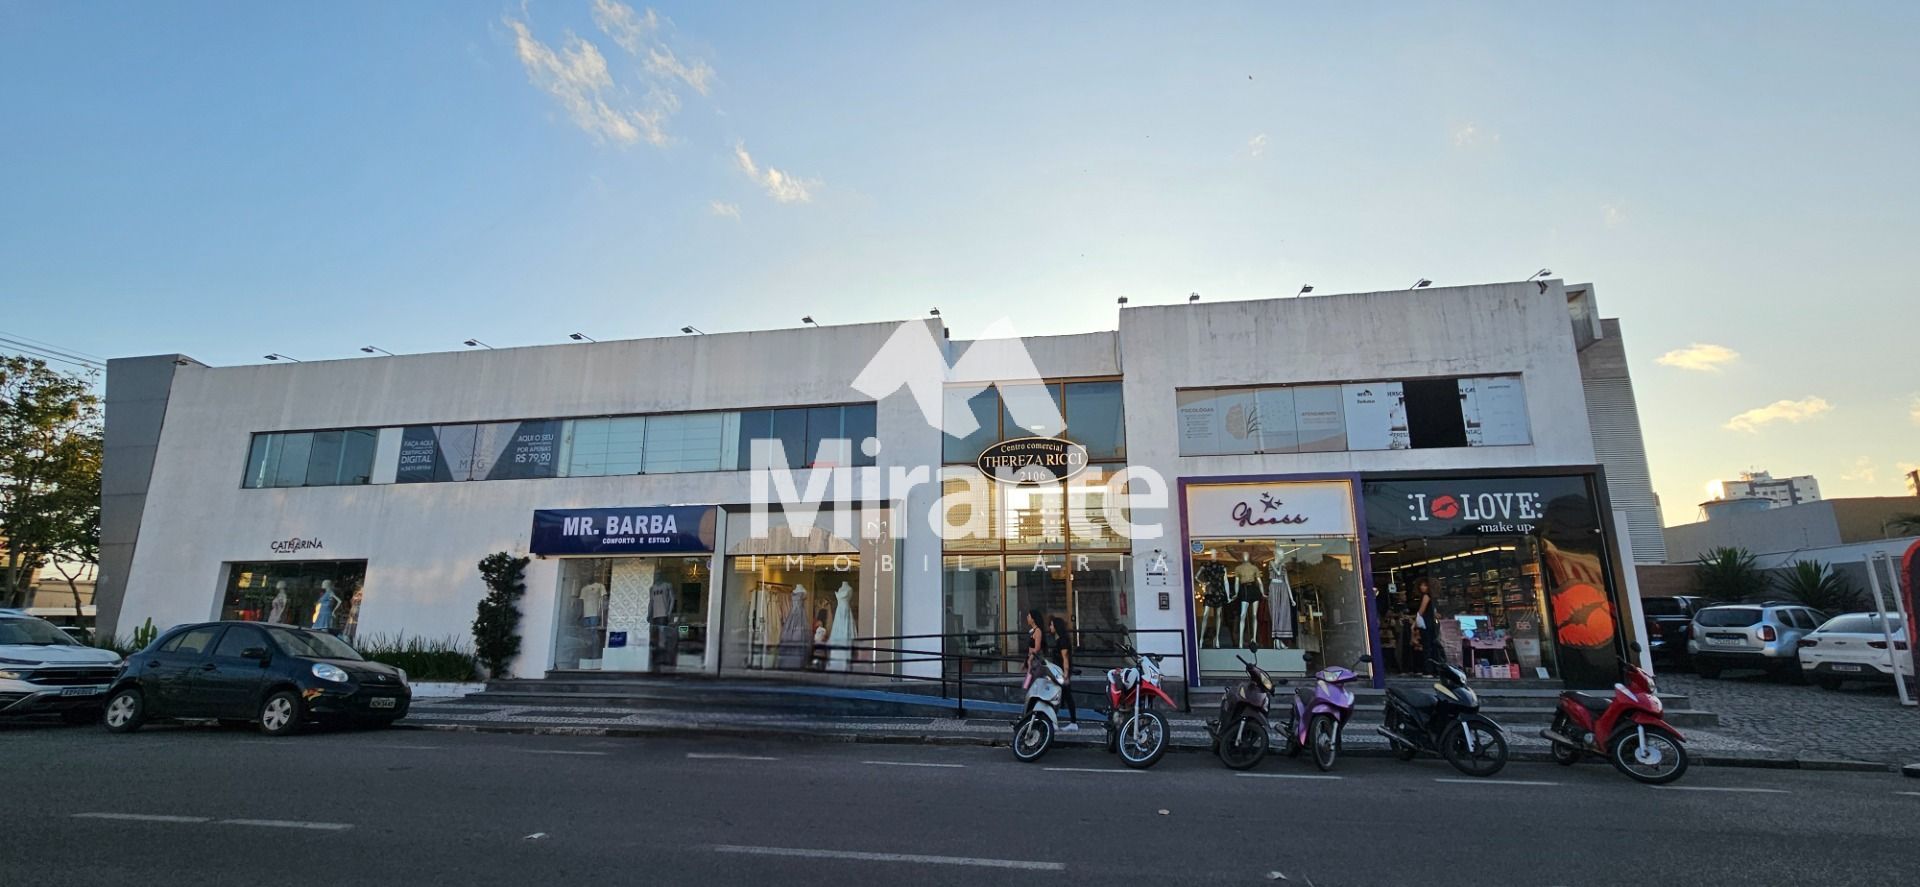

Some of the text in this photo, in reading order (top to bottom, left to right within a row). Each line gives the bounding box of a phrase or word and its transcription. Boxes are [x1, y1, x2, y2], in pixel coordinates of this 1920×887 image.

[1001, 442, 1063, 453] Centro comercial
[401, 455, 432, 464] DIGITAL
[528, 452, 551, 463] 79,90
[984, 453, 1083, 467] THEREZA RICCI
[1020, 471, 1046, 481] 2106
[1460, 492, 1536, 520] LOVE
[563, 514, 677, 536] MR. BARBA
[602, 537, 635, 545] CONFORTO
[648, 536, 671, 544] ESTILO
